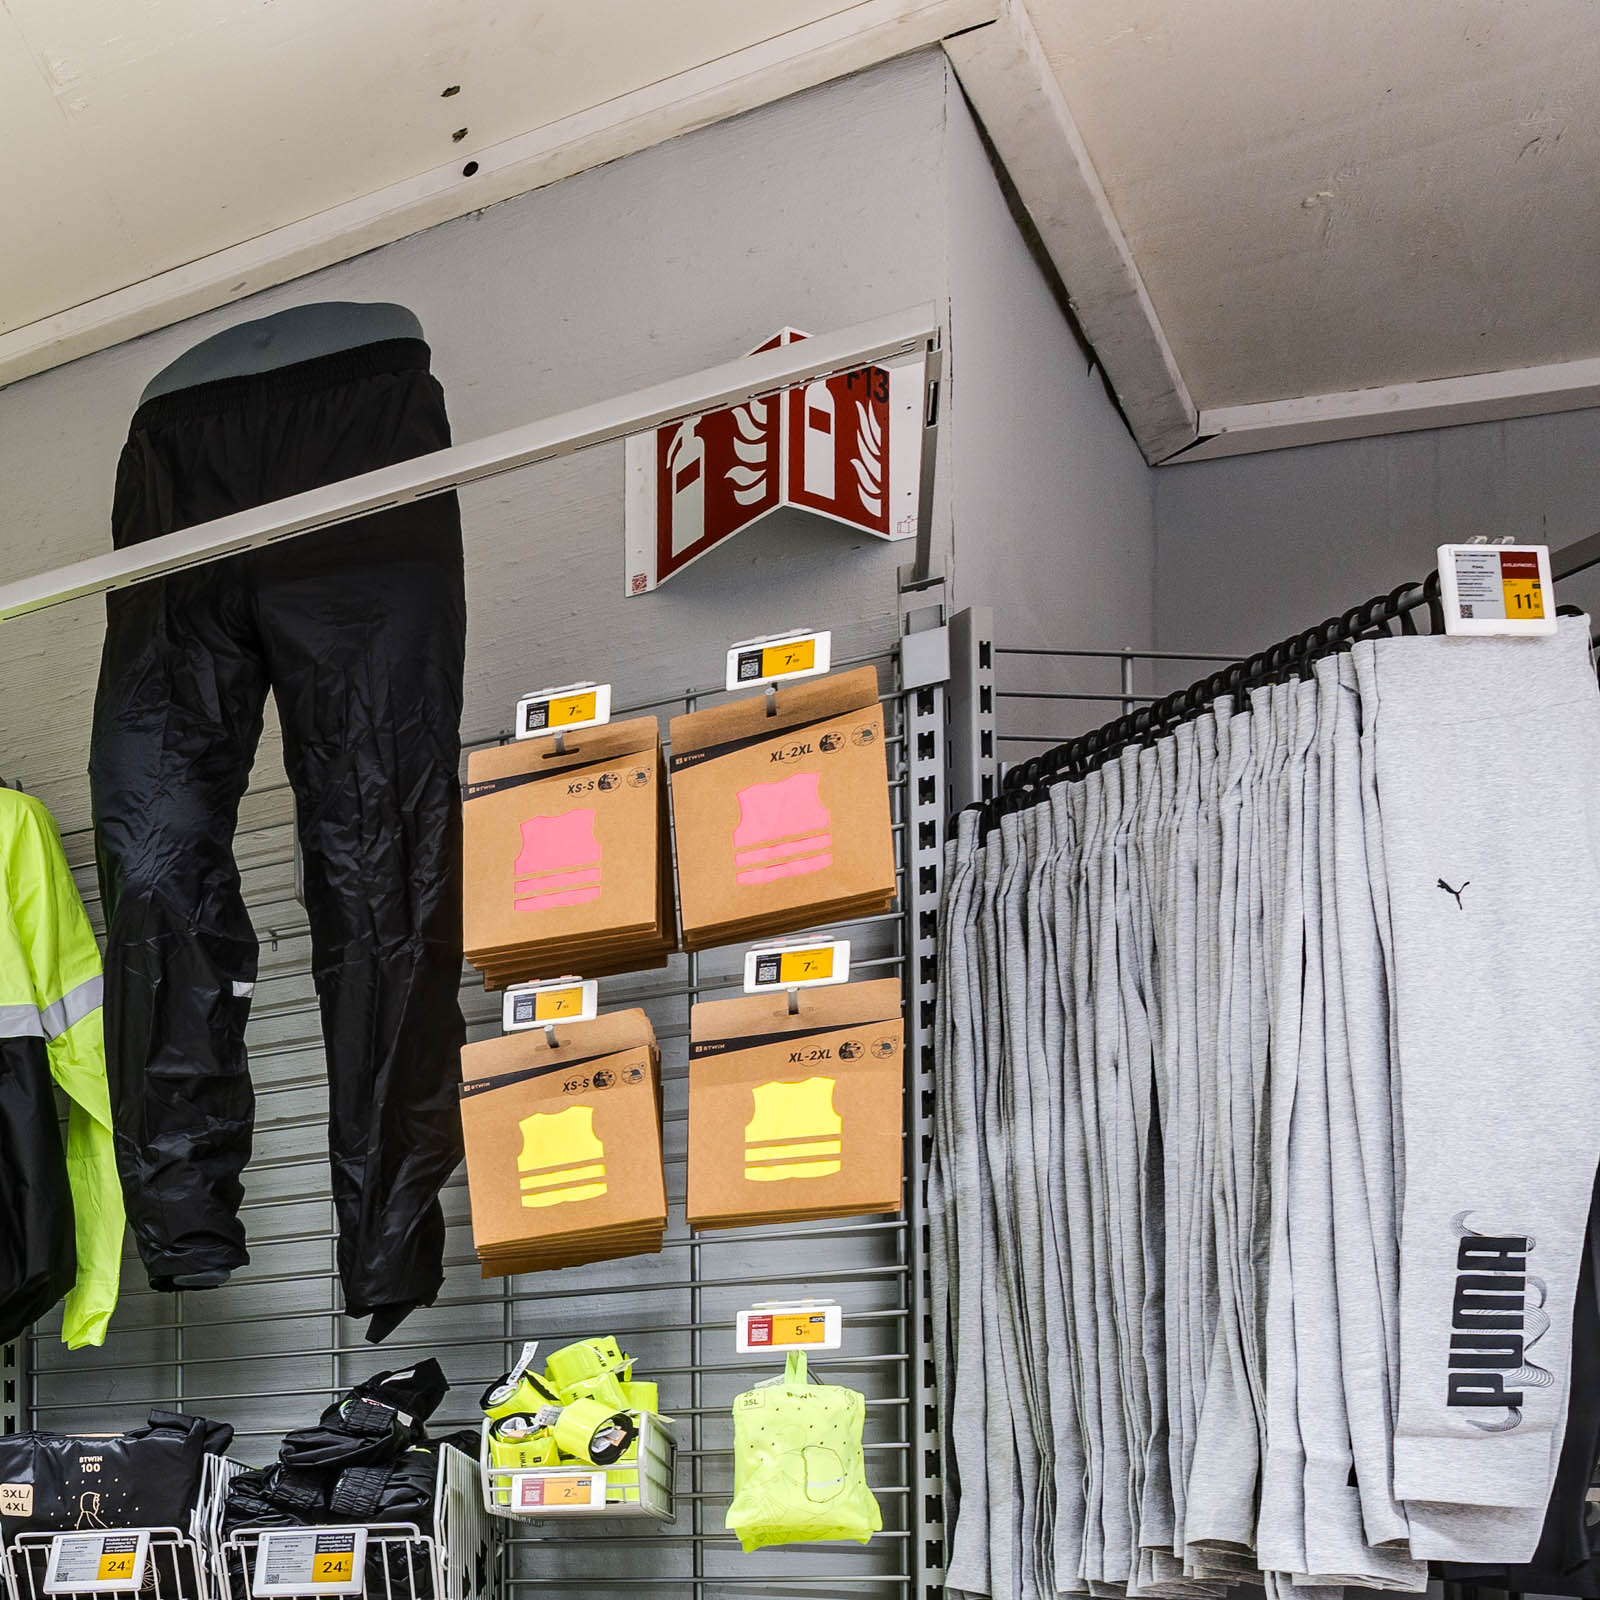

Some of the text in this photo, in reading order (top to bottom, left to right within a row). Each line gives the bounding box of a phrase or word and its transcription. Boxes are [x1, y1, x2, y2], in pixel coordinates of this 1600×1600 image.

[1514, 593, 1531, 609] 11
[784, 655, 793, 665] 7
[568, 706, 576, 716] 7
[770, 744, 813, 763] XL-2XL
[567, 781, 595, 795] XS-S
[803, 962, 811, 972] 7
[556, 1000, 563, 1010] 7
[788, 1049, 832, 1064] XL-2XL
[562, 1078, 590, 1093] XS-S
[1447, 1236, 1527, 1407] PUMA
[795, 1325, 803, 1336] 5
[79, 1455, 103, 1463] BTWIN
[81, 1464, 101, 1473] 100
[2, 1489, 31, 1499] 3XL/
[5, 1502, 28, 1512] 4XL
[107, 1560, 126, 1572] 24
[322, 1561, 343, 1574] 24
